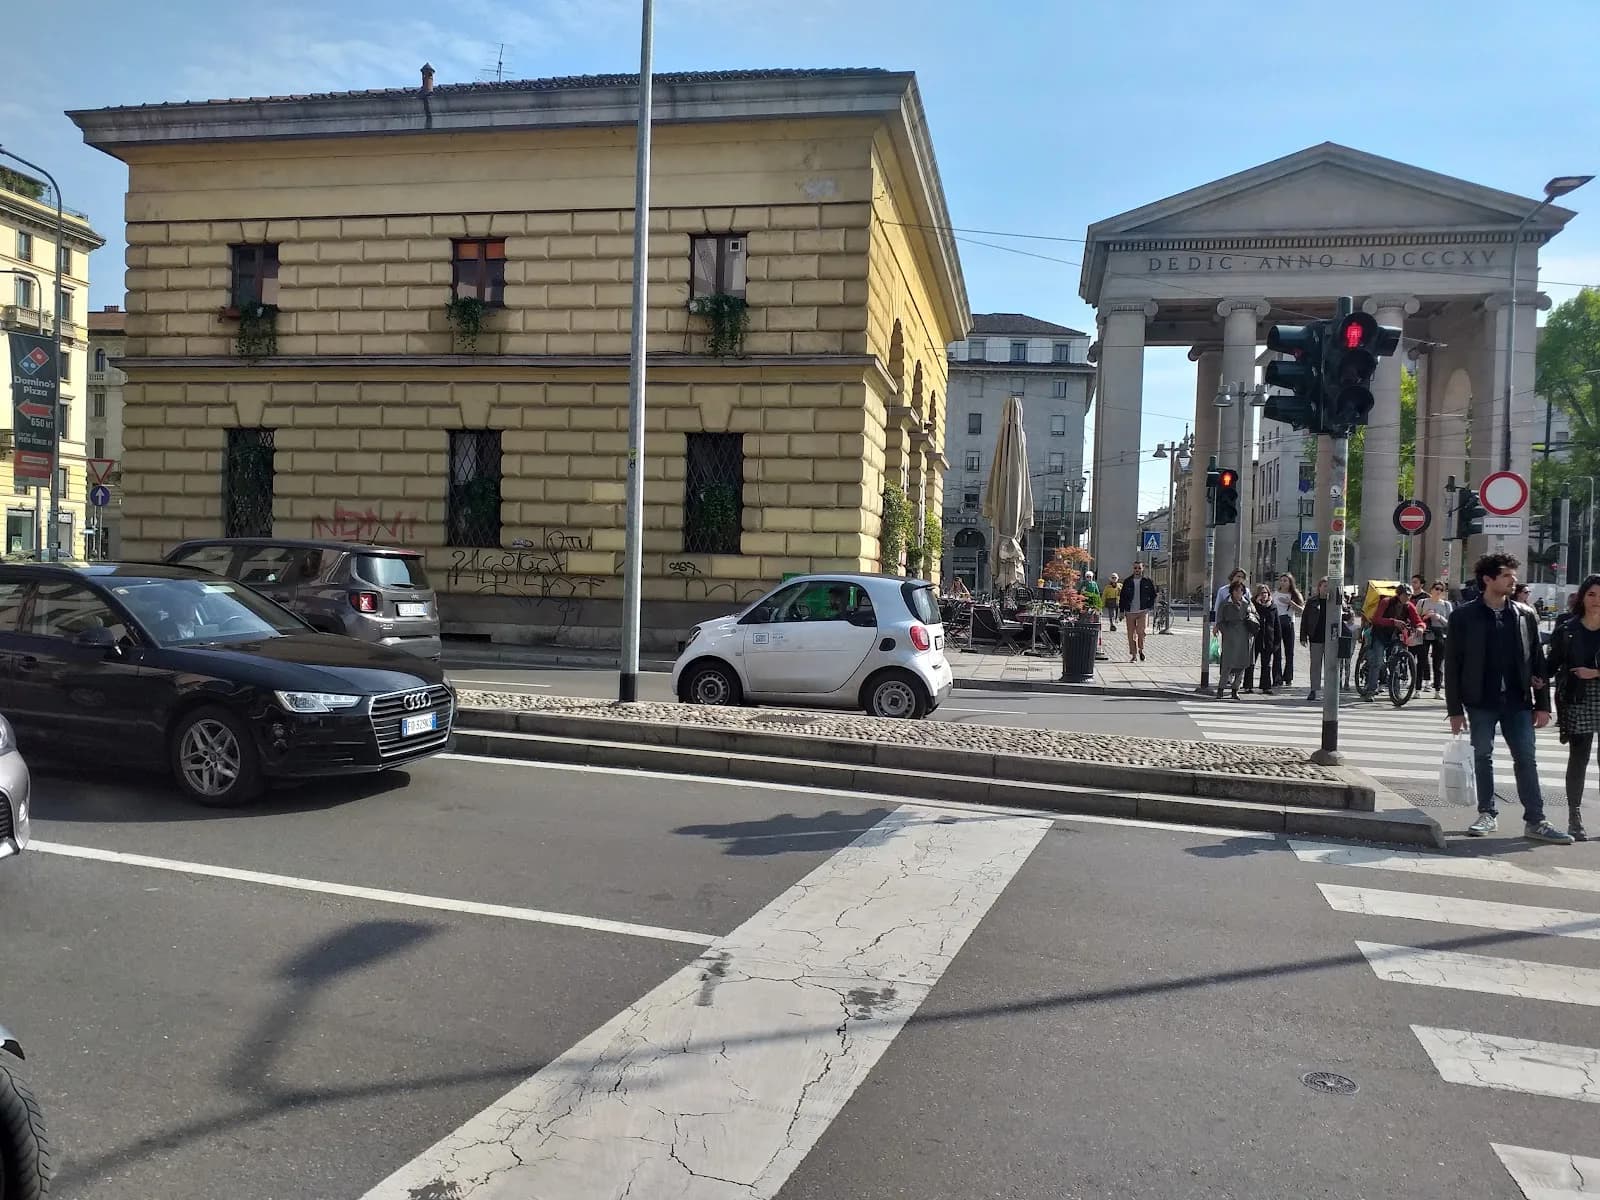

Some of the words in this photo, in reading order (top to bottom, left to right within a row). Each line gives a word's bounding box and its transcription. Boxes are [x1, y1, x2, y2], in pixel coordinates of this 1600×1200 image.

[1149, 256, 1233, 271] DEDIC
[1259, 253, 1333, 270] ANNO
[1359, 250, 1496, 268] MDCCCXV
[14, 375, 55, 389] Domino's
[23, 385, 48, 397] Pizza
